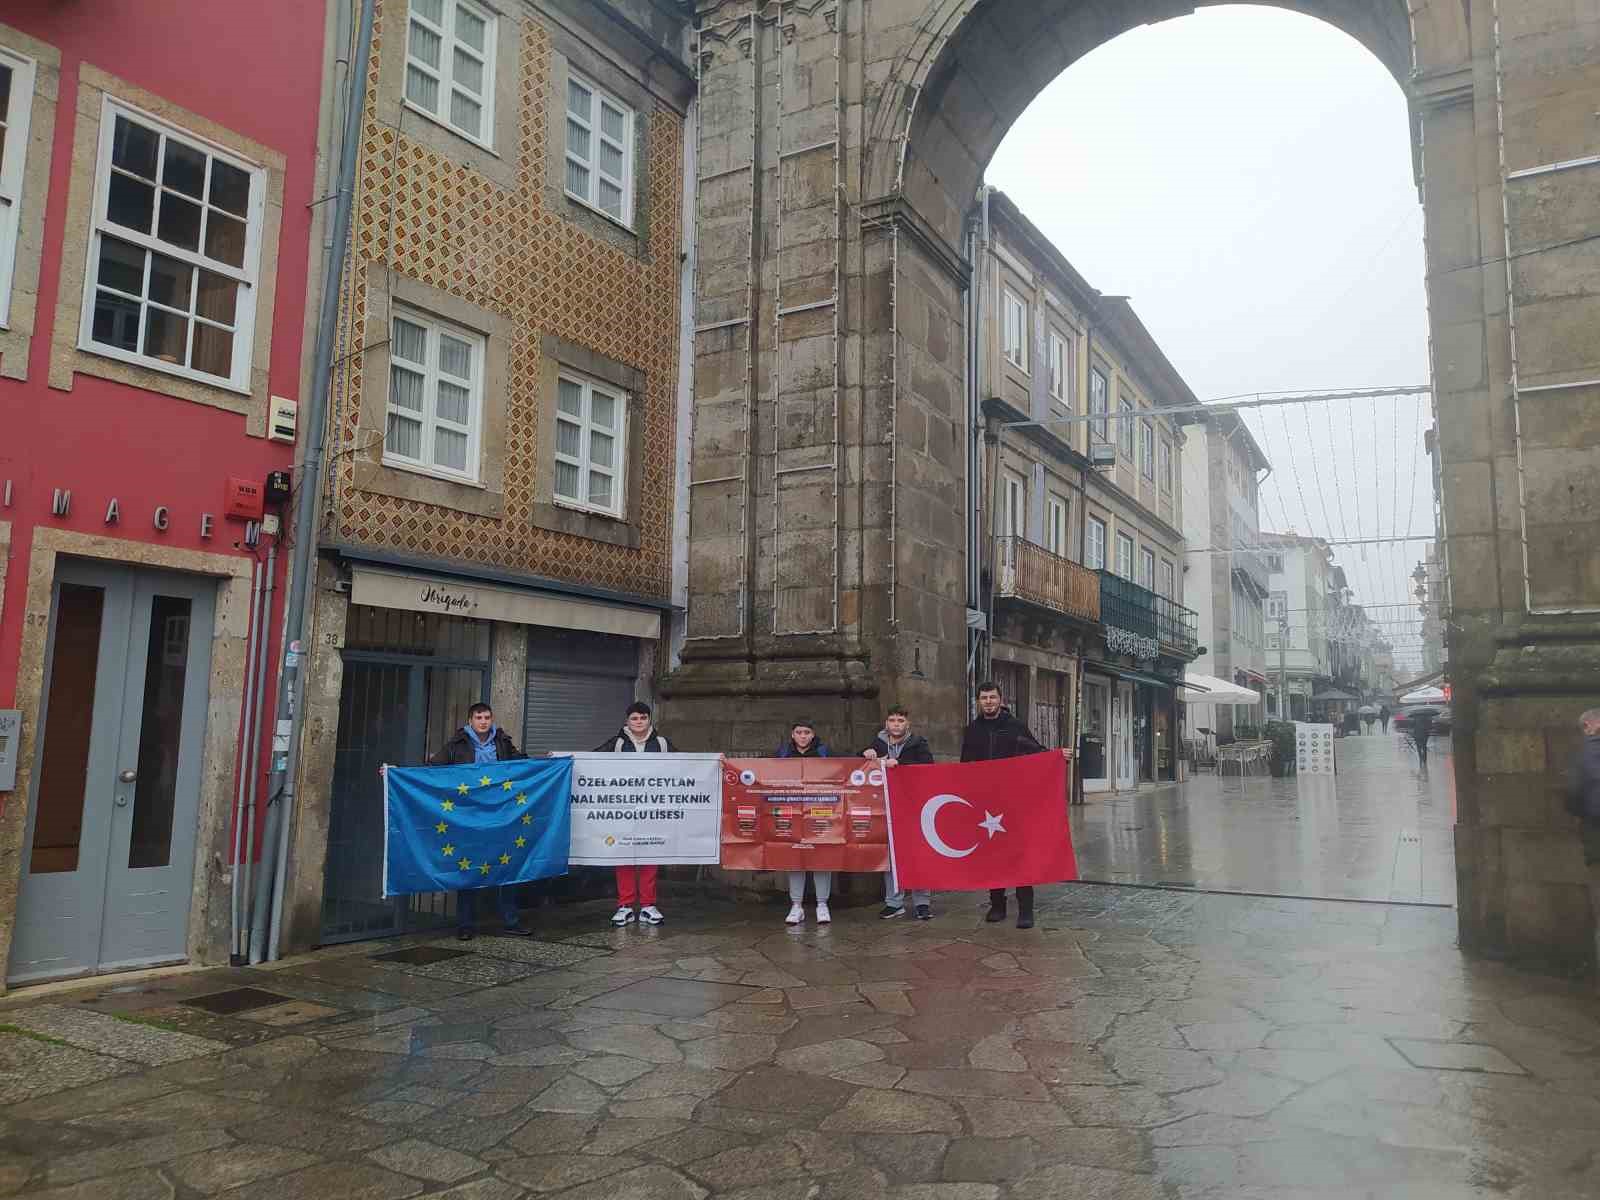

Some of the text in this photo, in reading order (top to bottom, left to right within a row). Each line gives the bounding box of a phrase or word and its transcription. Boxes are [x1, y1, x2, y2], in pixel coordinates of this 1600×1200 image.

[325, 633, 338, 645] 38
[578, 775, 696, 788] ÖZEL ADEM CEYLAN
[599, 792, 648, 804] MESLEKİ
[651, 795, 666, 804] VE
[668, 792, 711, 804] TEKNİK
[587, 810, 647, 820] ANADOLU
